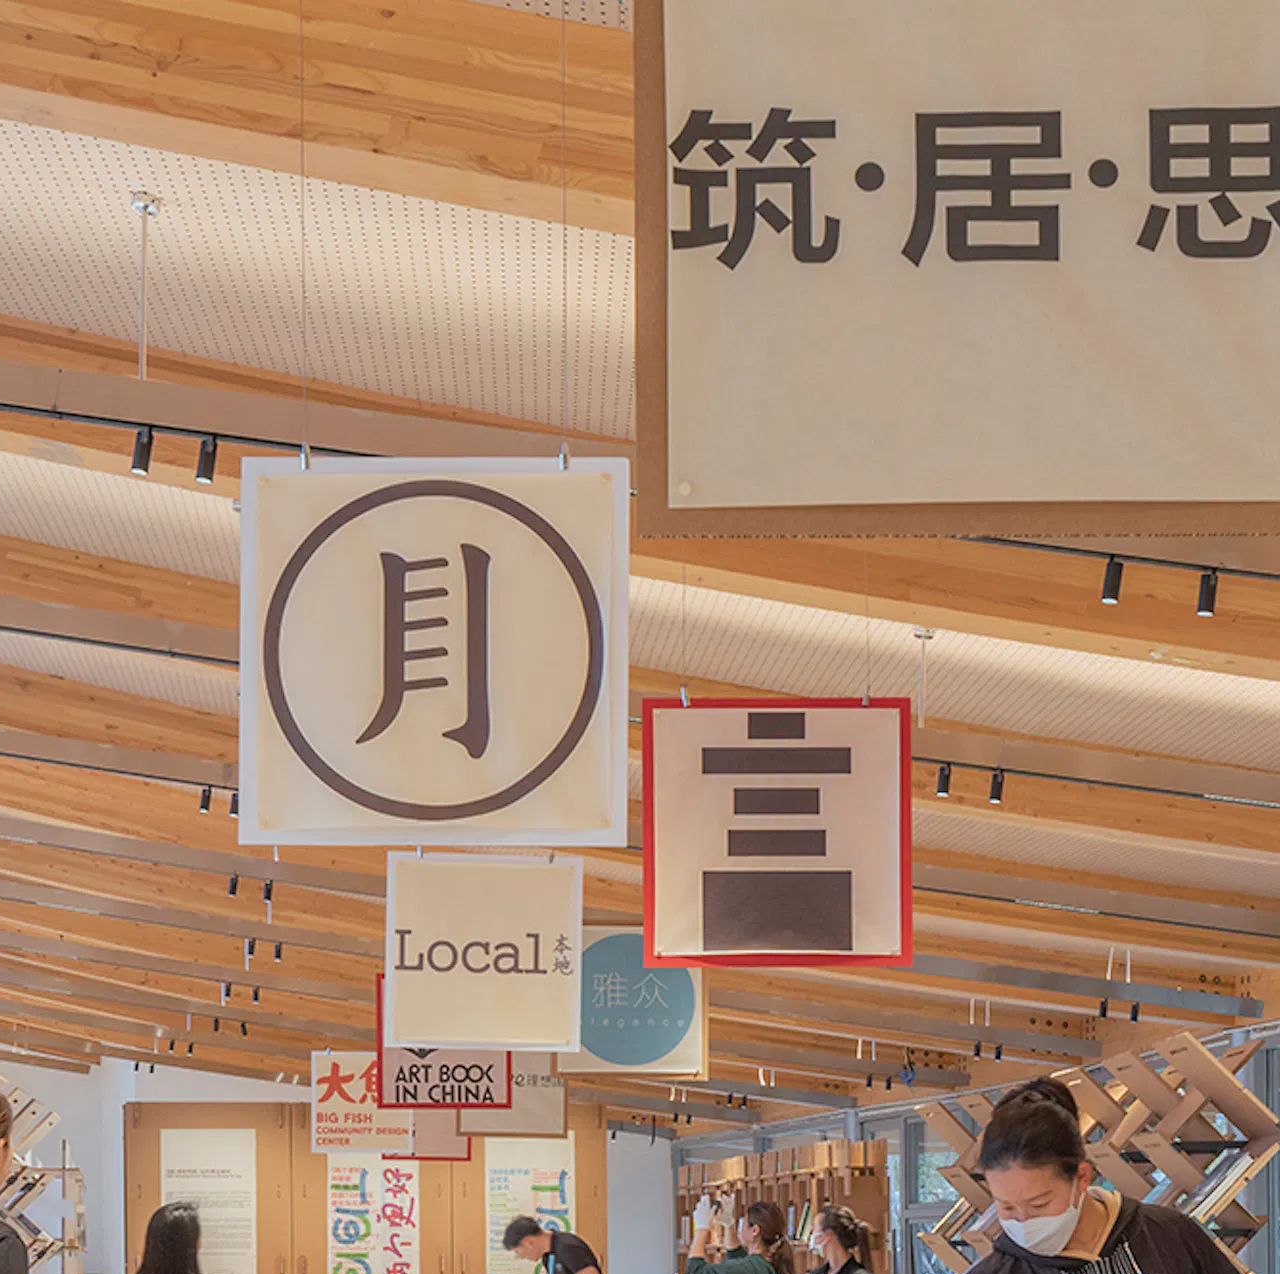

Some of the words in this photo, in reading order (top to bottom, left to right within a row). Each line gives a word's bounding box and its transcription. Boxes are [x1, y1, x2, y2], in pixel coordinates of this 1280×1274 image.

[394, 929, 548, 975] Local
[552, 933, 574, 977] 本地
[591, 971, 670, 1009] 雅众
[581, 1016, 686, 1029] legance
[395, 1065, 432, 1084] ART
[440, 1064, 494, 1084] BOOK
[395, 1085, 418, 1103] IN
[428, 1085, 495, 1104] CHINA
[316, 1112, 339, 1124] BIG
[344, 1112, 373, 1124] FISH
[316, 1126, 372, 1135] COMMUNITY
[376, 1127, 409, 1136] DESIGN
[316, 1136, 351, 1146] CENTER
